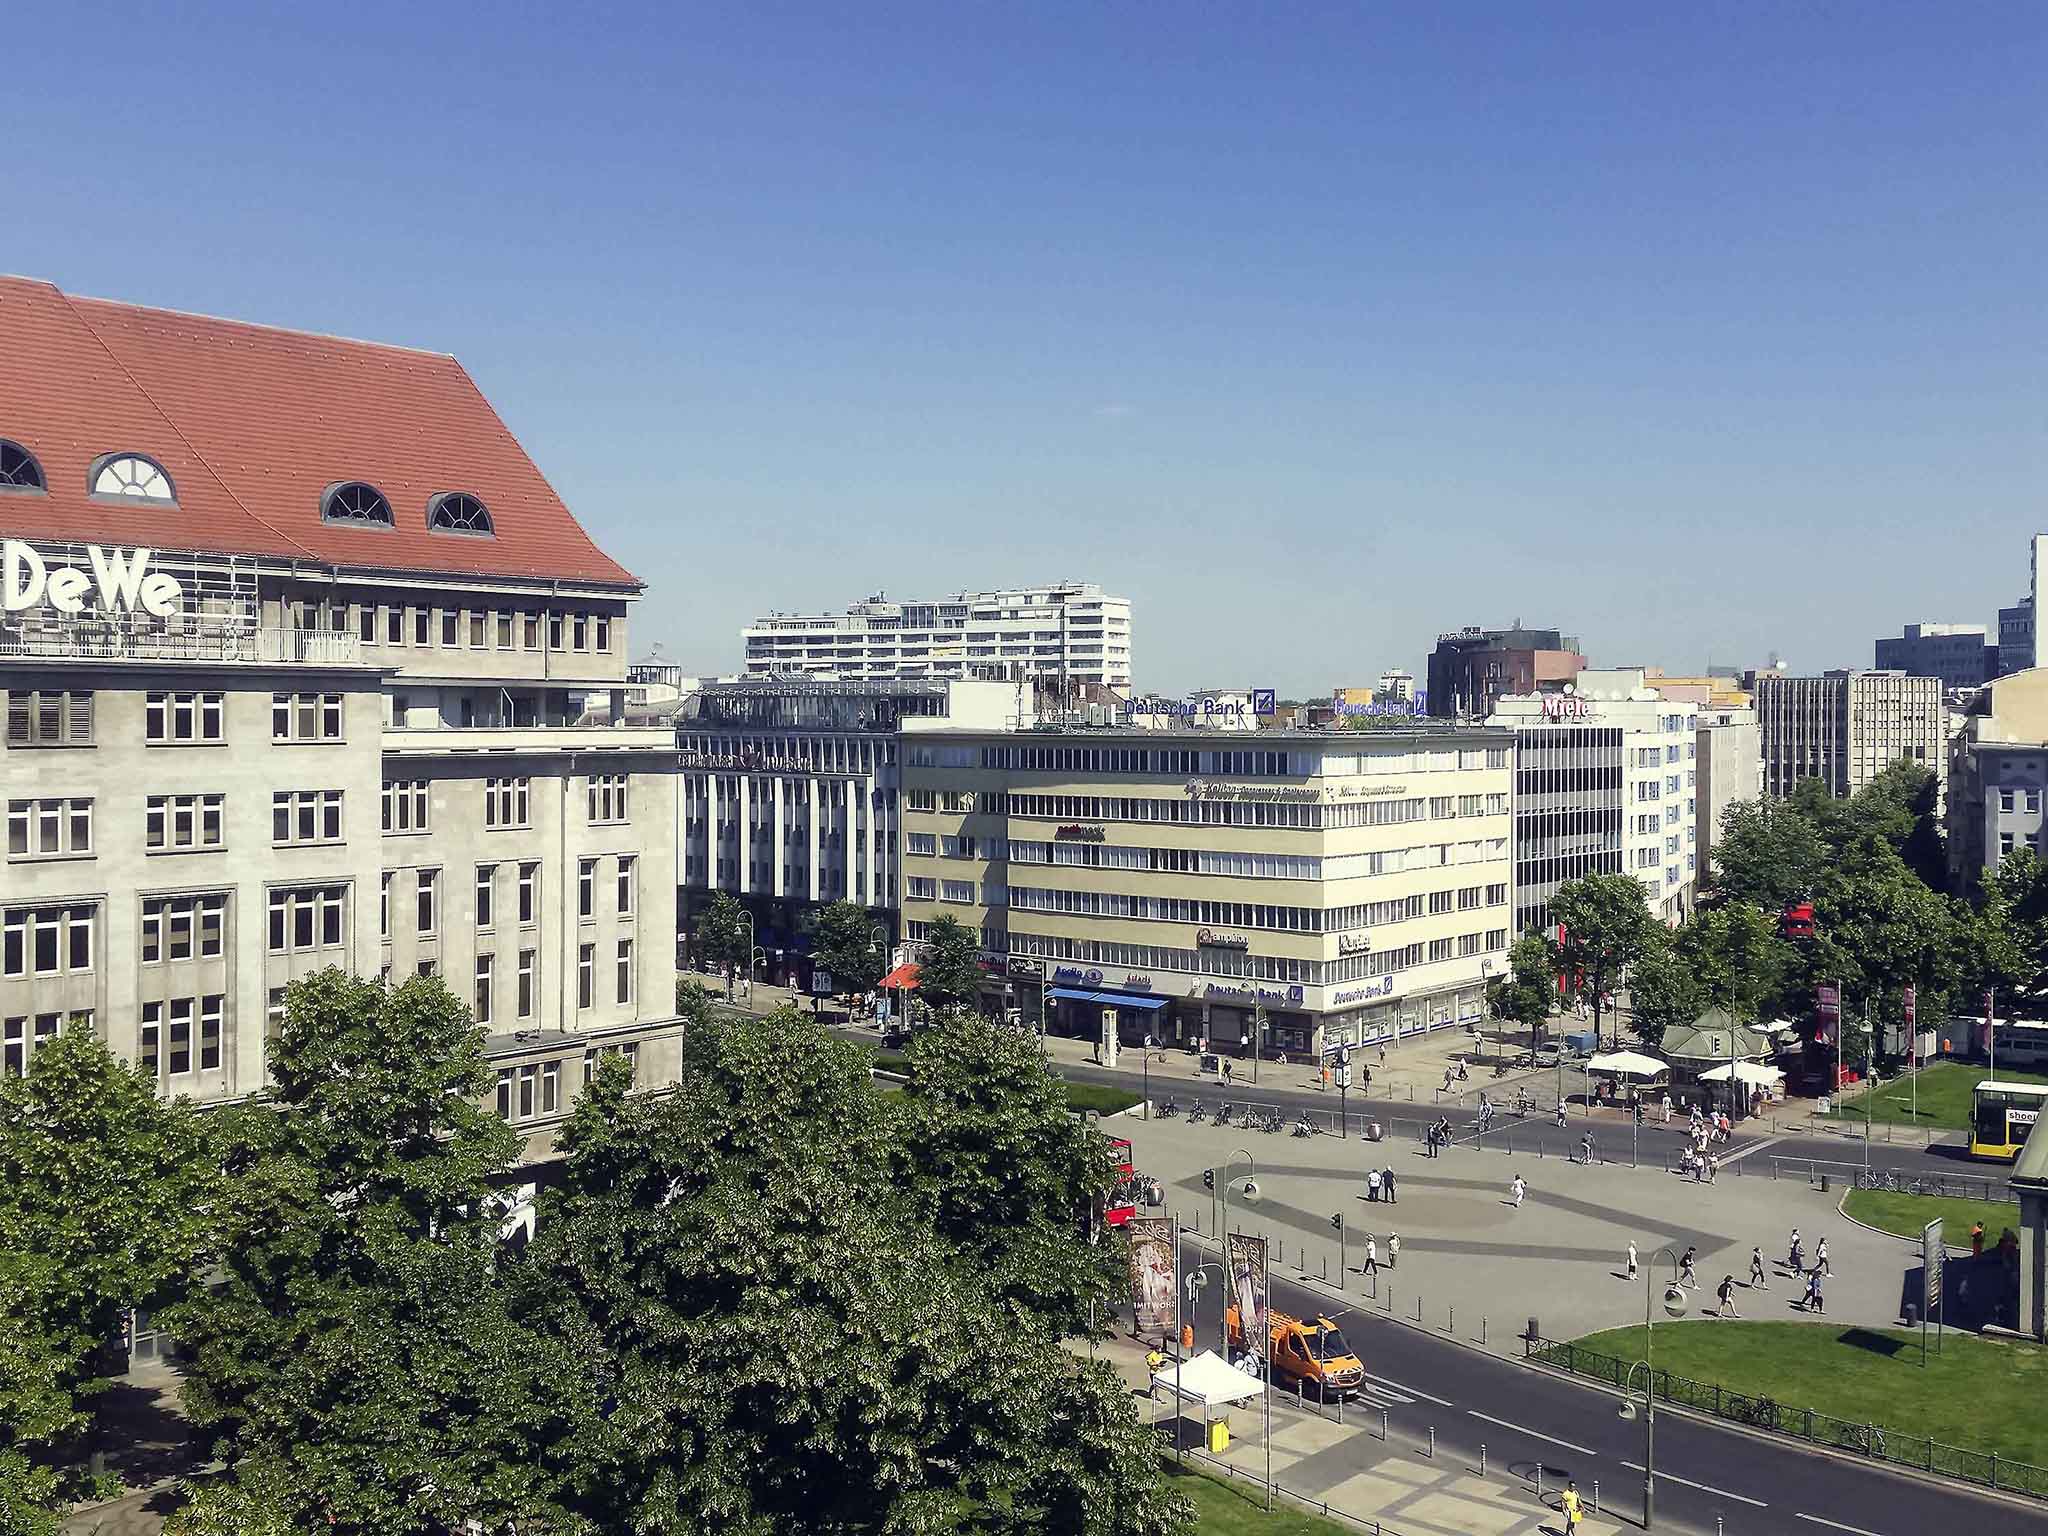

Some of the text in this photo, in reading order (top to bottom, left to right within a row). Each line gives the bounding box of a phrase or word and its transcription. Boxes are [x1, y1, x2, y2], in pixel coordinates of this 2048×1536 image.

[3, 540, 183, 617] DeWe
[1125, 699, 1245, 715] Deutsche Bank
[1542, 699, 1590, 717] Miele
